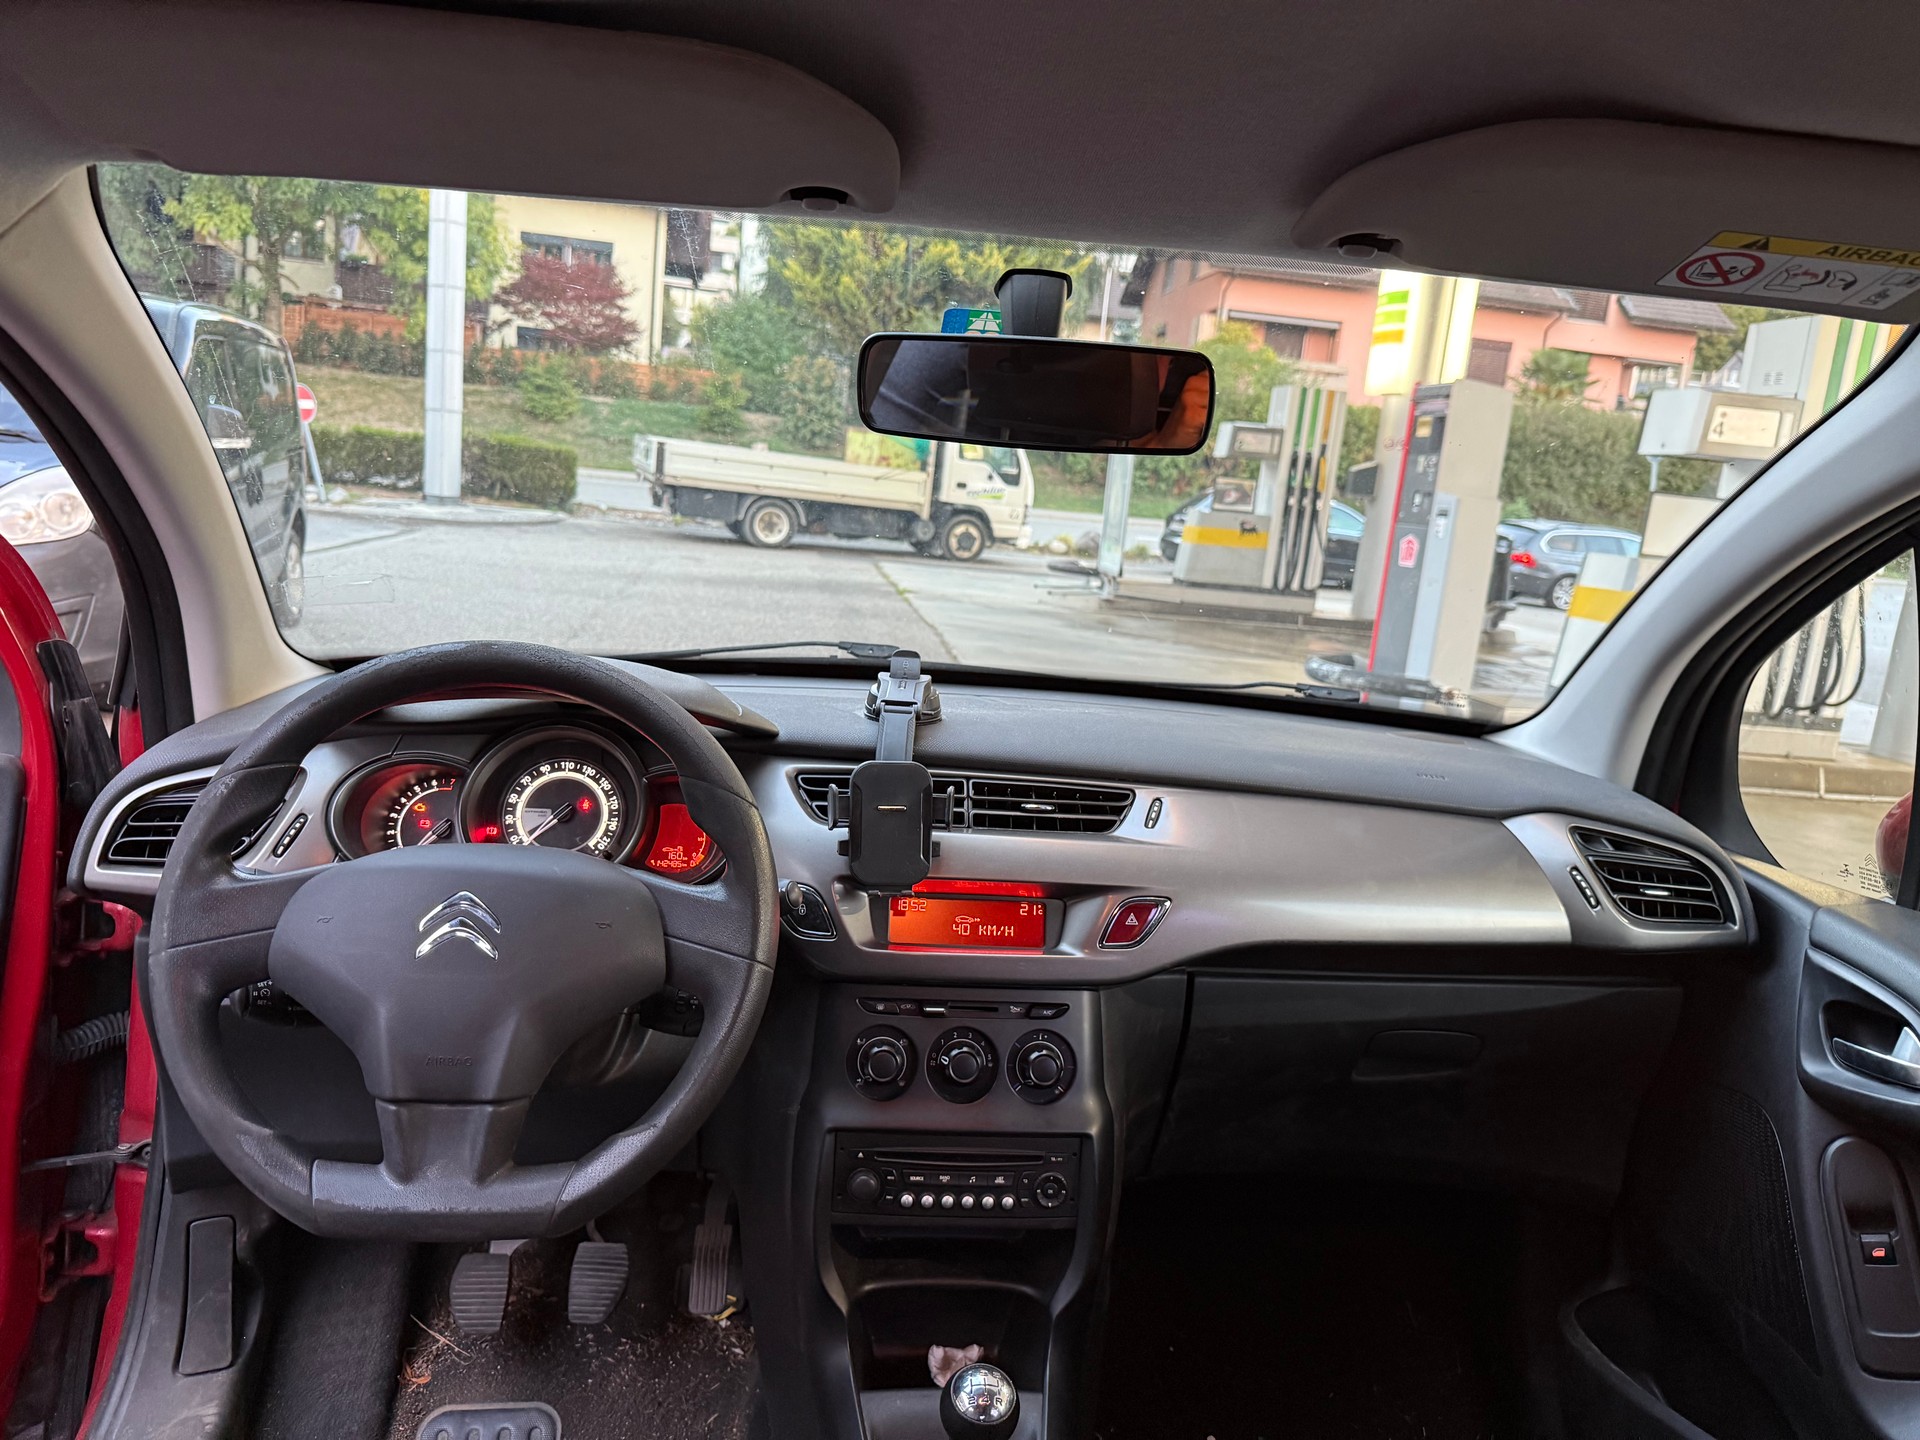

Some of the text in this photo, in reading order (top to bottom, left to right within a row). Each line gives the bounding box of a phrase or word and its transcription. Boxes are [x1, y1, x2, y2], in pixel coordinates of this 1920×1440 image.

[1712, 421, 1725, 437] 4
[539, 764, 551, 774] 90
[560, 761, 575, 770] 110
[582, 765, 596, 777] 130
[520, 775, 532, 786] 70
[599, 777, 612, 791] 150
[413, 785, 421, 793] 5
[508, 793, 519, 805] 50
[609, 795, 619, 810] 170
[505, 814, 514, 825] 30
[608, 817, 619, 831] 190
[597, 836, 611, 851] 210
[668, 851, 683, 861] 160
[952, 924, 1014, 937] 40 KM/H
[425, 1056, 473, 1067] AIRBAG
[968, 1396, 977, 1406] 2
[980, 1394, 991, 1406] 4
[994, 1396, 1003, 1407] R
